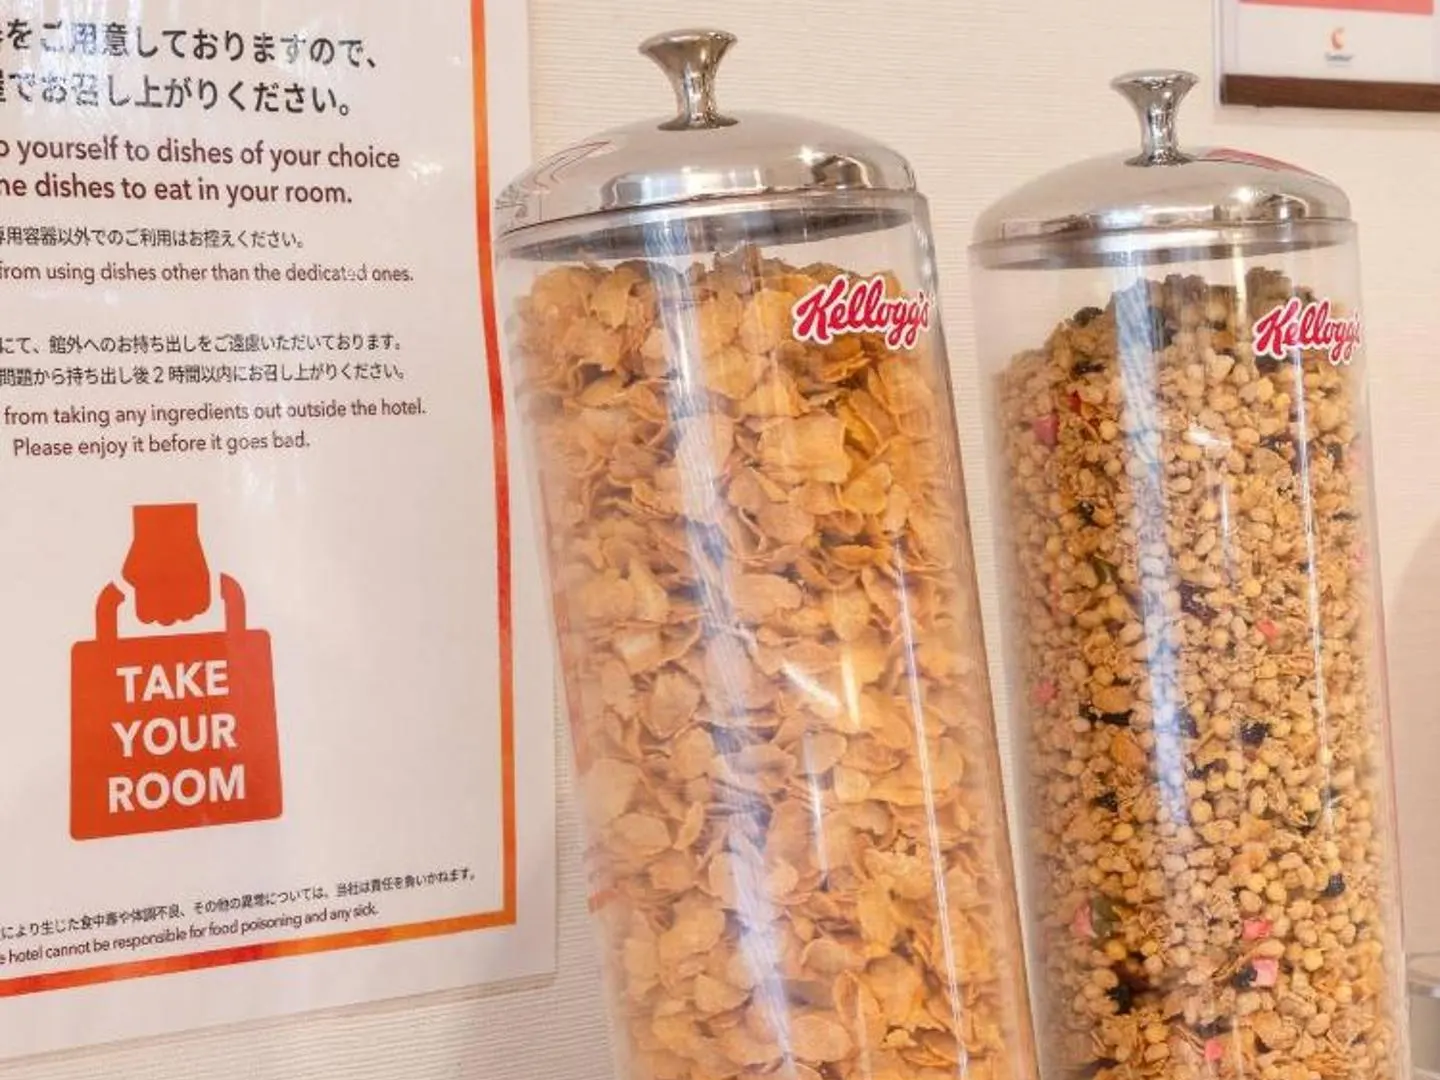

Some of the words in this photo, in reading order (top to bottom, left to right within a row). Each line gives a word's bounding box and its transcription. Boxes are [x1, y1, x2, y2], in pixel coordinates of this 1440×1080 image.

[0, 18, 376, 68] をご用意しておりますので、
[0, 68, 350, 116] でお召し上がりください。
[17, 135, 119, 165] yourself
[125, 140, 150, 161] to
[157, 138, 234, 164] dishes
[240, 140, 264, 164] of
[270, 148, 321, 172] your
[328, 143, 400, 168] choice
[35, 172, 115, 198] dishes
[121, 177, 147, 199] to
[155, 179, 193, 200] eat
[198, 176, 220, 200] in
[226, 184, 279, 208] your
[286, 185, 352, 203] room.
[47, 262, 95, 285] using
[101, 262, 156, 281] dishes
[161, 262, 207, 281] other
[211, 263, 249, 281] than
[254, 263, 281, 281] the
[285, 263, 367, 281] dedicated
[372, 269, 414, 281] ones.
[796, 277, 930, 346] Kellogg's
[4, 406, 48, 425] from
[54, 405, 110, 427] taking
[115, 410, 147, 427] any
[151, 402, 250, 426] ingredients
[254, 404, 282, 420] out
[287, 401, 347, 418] outside
[351, 400, 377, 416] the
[382, 398, 427, 416] hotel.
[14, 437, 73, 456] Please
[78, 437, 128, 459] enjoy
[132, 436, 144, 452] it
[150, 434, 206, 453] before
[211, 434, 222, 450] it
[226, 440, 268, 455] goes
[272, 430, 310, 448] bad.
[116, 660, 230, 703] TAKE
[111, 713, 238, 758] YOUR
[109, 764, 246, 814] ROOM
[9, 948, 43, 964] hotel
[45, 941, 91, 959] cannot
[93, 938, 110, 953] be
[113, 926, 188, 951] responsible
[189, 924, 207, 938] for
[209, 919, 239, 936] food
[241, 911, 302, 934] poisoning
[305, 908, 327, 924] and
[330, 908, 351, 922] any
